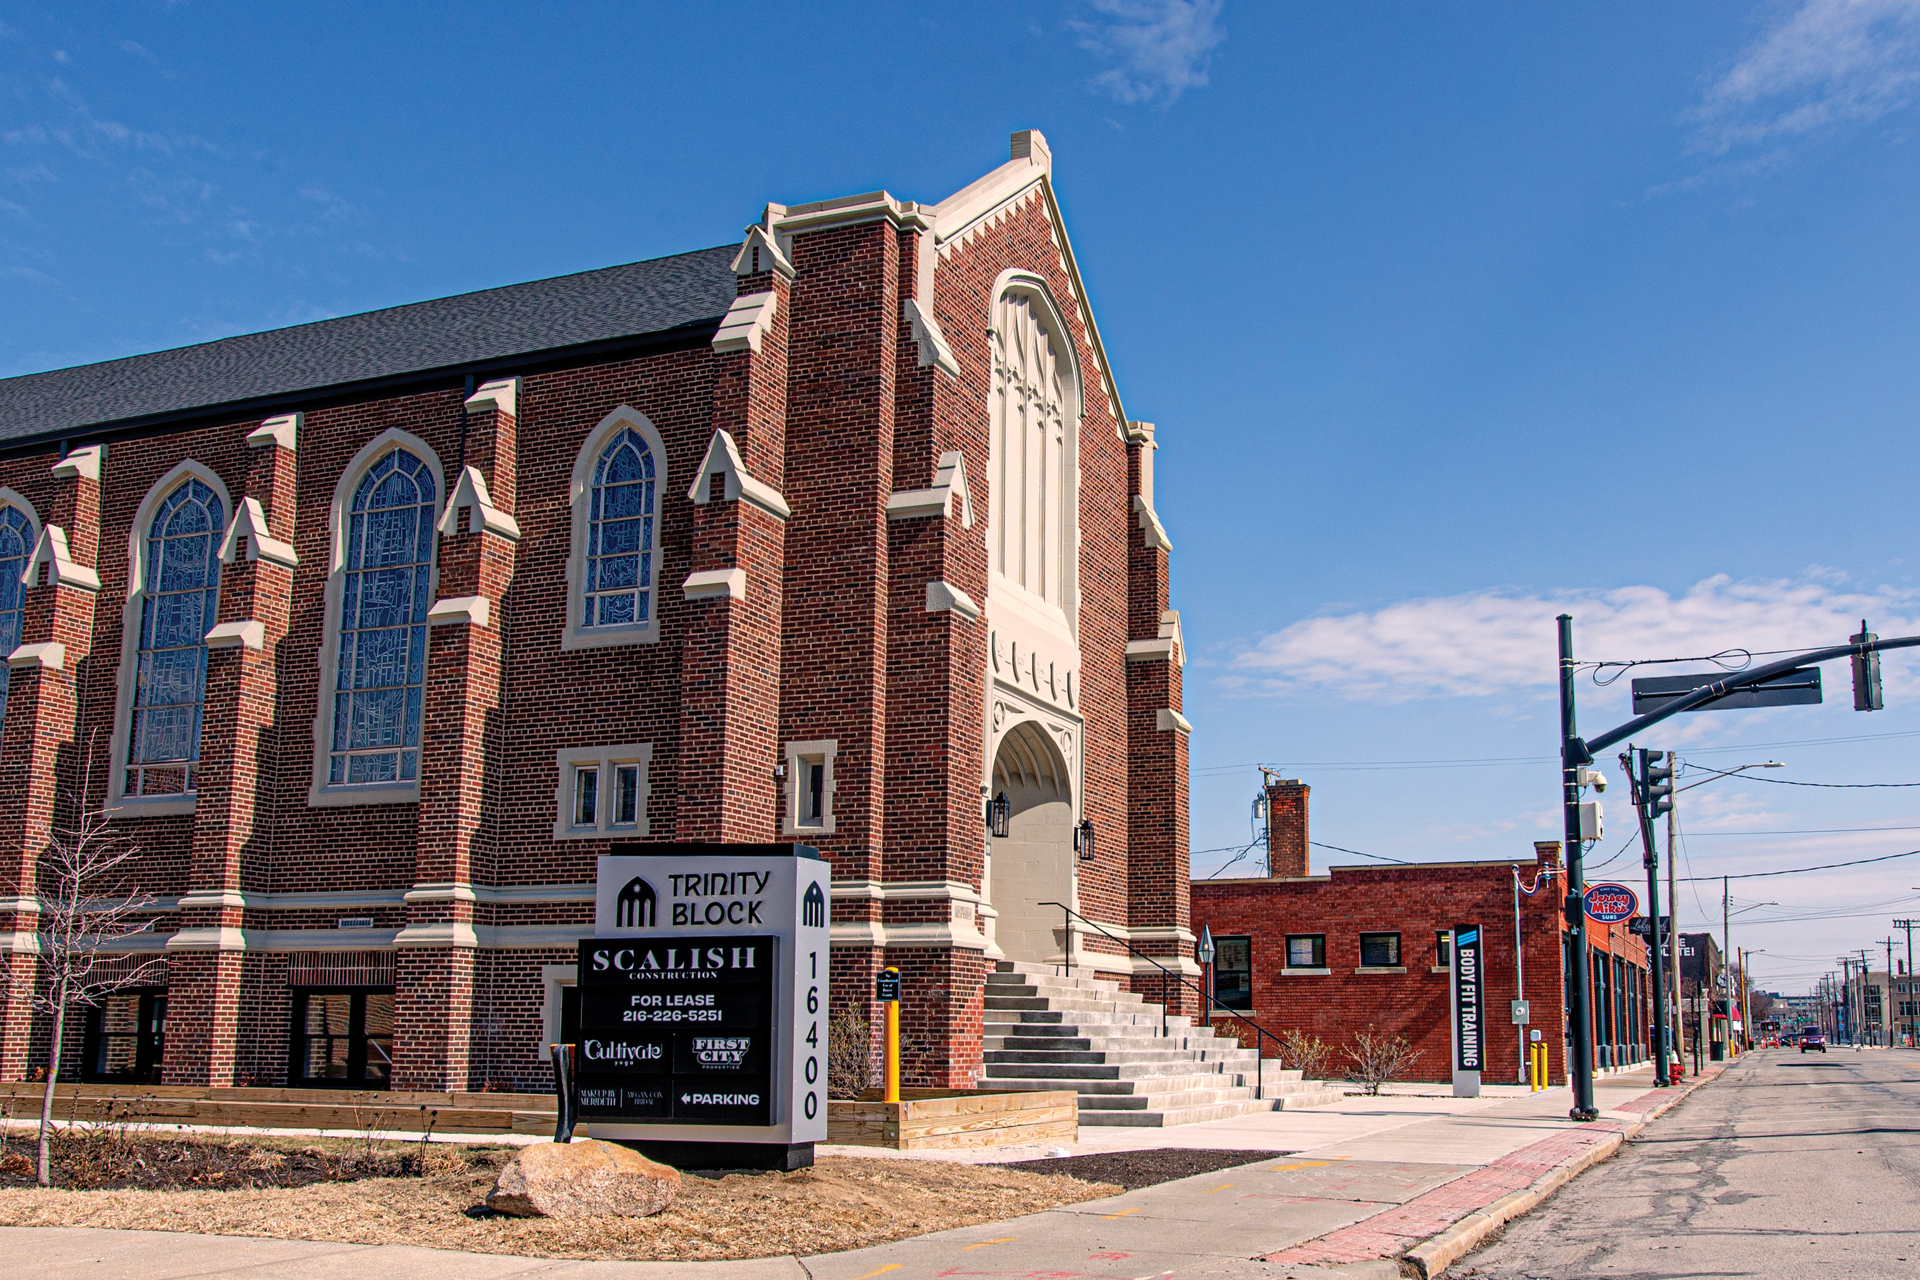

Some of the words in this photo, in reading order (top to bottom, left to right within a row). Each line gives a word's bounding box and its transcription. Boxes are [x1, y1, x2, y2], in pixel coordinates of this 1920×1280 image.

[668, 871, 770, 897] TRINITY
[1589, 891, 1629, 905] Jersey
[672, 901, 763, 926] BLOCK
[1591, 902, 1629, 913] Mike's
[592, 947, 756, 971] SCALISH
[1460, 949, 1476, 982] BODY
[629, 971, 718, 980] CONSTRUCTION
[631, 995, 662, 1007] FOR
[666, 994, 715, 1007] LEASE
[1461, 984, 1476, 1003] FIT
[623, 1010, 722, 1022] 216-226-5251
[804, 951, 819, 1120] 16400
[1462, 1005, 1478, 1067] TRAINING
[584, 1039, 663, 1060] Cultivate
[695, 1039, 749, 1050] FIRST
[699, 1050, 744, 1062] CITY
[692, 1093, 760, 1105] PARKING
